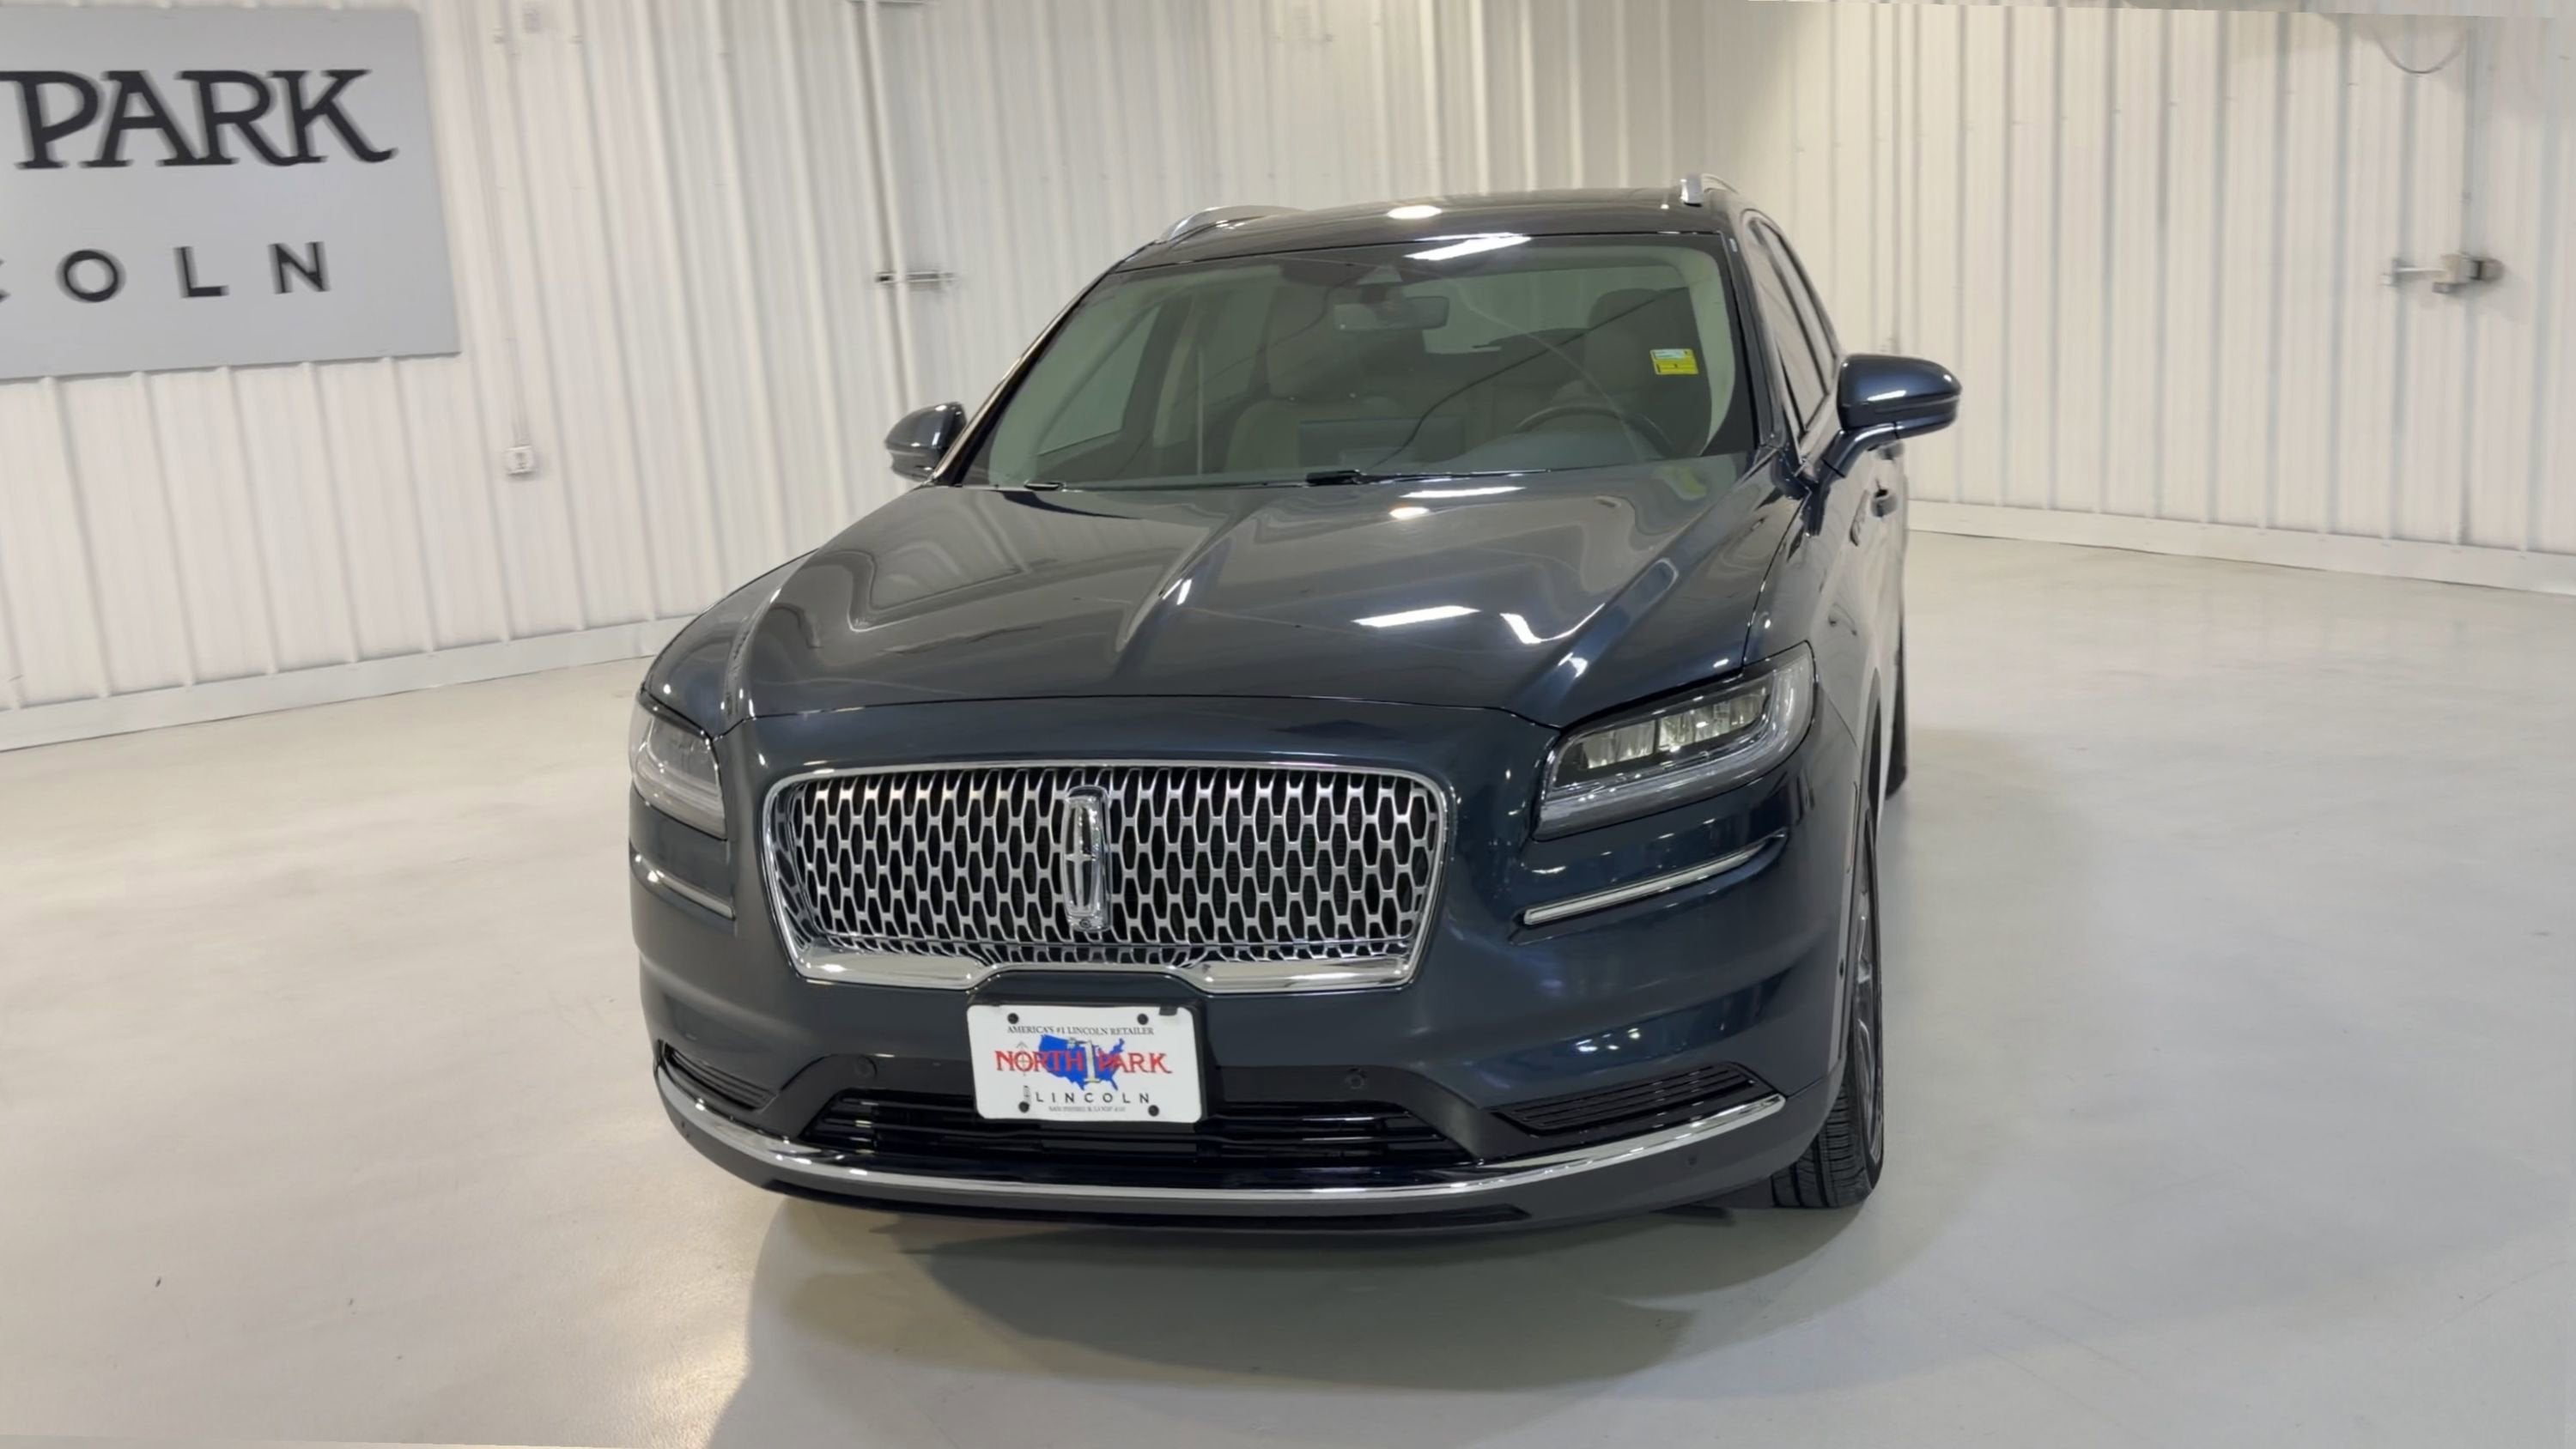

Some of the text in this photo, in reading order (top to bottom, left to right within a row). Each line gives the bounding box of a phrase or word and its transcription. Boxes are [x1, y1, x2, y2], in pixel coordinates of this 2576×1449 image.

[0, 69, 398, 169] PARK
[0, 241, 331, 303] OLN
[1066, 1027, 1108, 1035] LINCOLN
[1110, 1027, 1154, 1036] RETAILER
[994, 1050, 1172, 1074] NORTH PARK
[1036, 1091, 1150, 1104] LINCOLN
